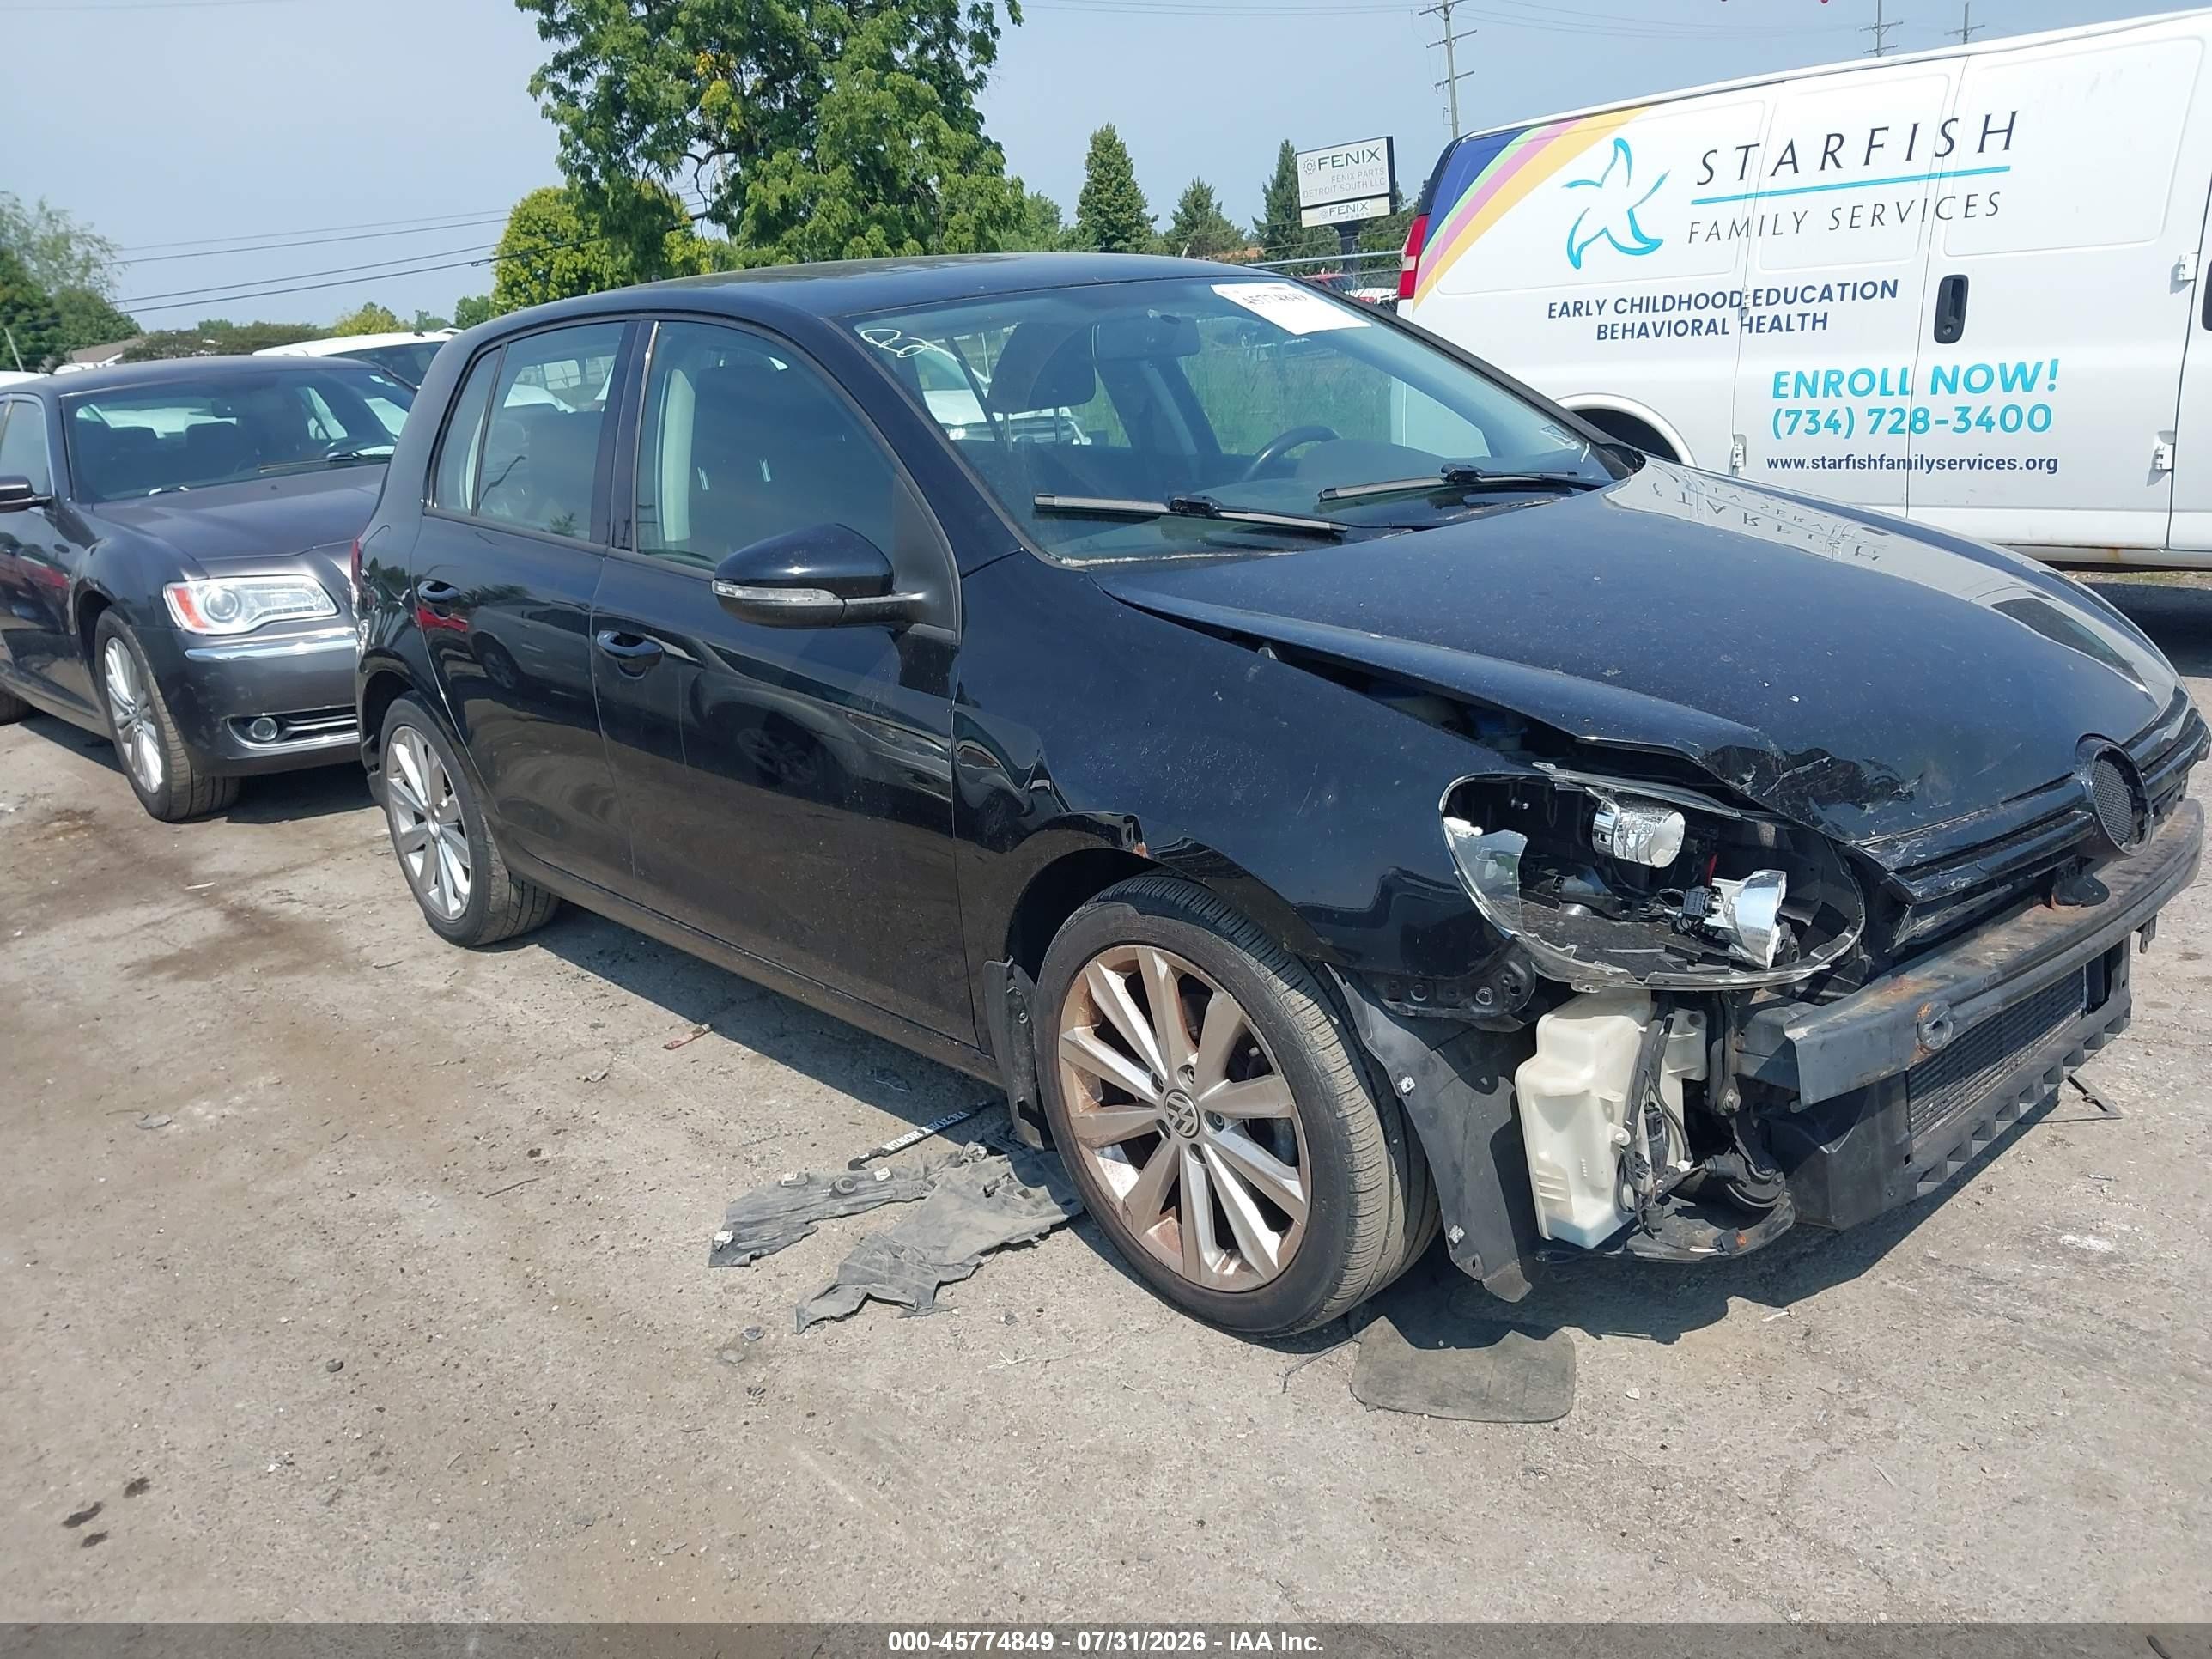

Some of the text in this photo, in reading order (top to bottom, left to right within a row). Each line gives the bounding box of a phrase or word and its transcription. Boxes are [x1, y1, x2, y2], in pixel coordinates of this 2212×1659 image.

[1317, 146, 1382, 171] FENIX
[1696, 110, 2019, 186] STARFISH
[1303, 177, 1386, 199] DETROIT SOUTH LLC
[1331, 167, 1385, 184] FENIX PARTS
[1328, 200, 1370, 217] FENIX
[1688, 191, 2001, 244] FAMILY SERVICES
[1547, 279, 1899, 319] EARLY CHILDHOOD EDUCATION
[1596, 311, 1828, 341] BEHAVIORAL HEALTH
[1772, 359, 2059, 399] ENROLL NOW!
[1772, 404, 2053, 440] (734) 728-3400
[1766, 453, 2058, 475] www.starfishfamilyservices.org
[881, 1130, 924, 1152] HONDA
